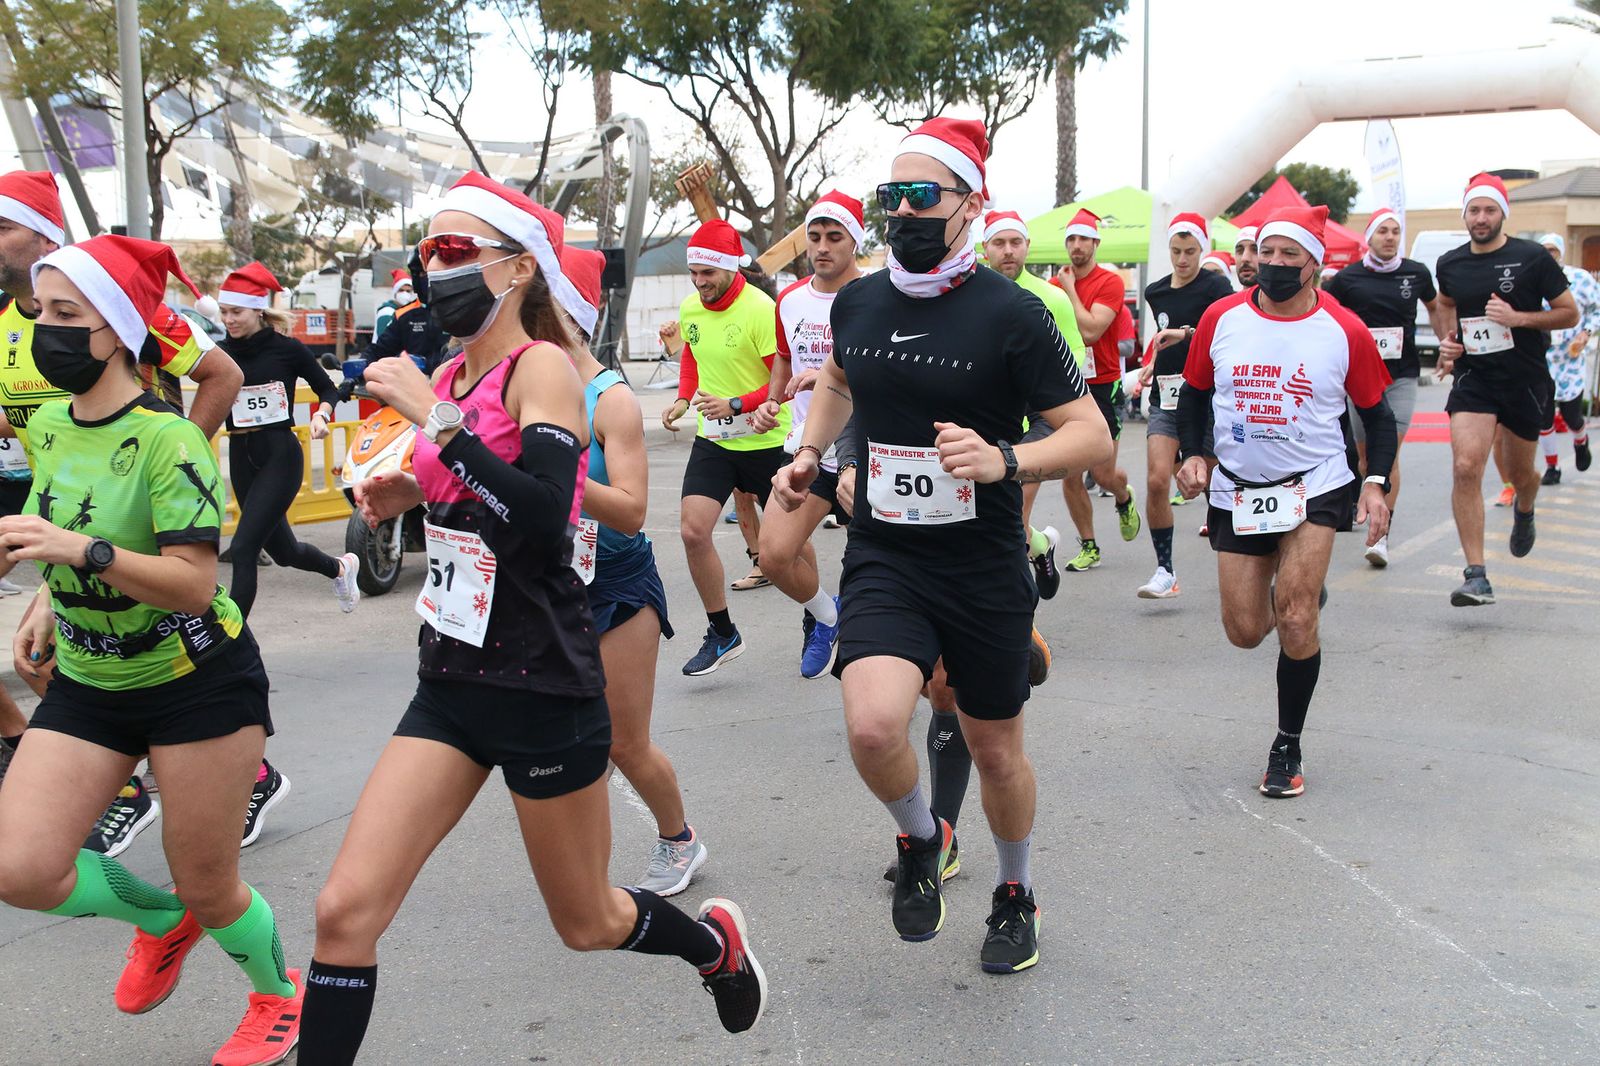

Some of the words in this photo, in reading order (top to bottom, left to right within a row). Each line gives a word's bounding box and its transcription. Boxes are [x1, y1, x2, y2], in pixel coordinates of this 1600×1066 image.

[680, 163, 712, 194] INRI
[695, 250, 723, 263] Navidad
[823, 323, 833, 340] Co
[1473, 329, 1490, 340] 41
[1232, 365, 1249, 376] XII
[1252, 364, 1282, 378] SAN
[12, 380, 34, 392] AGRO
[1233, 379, 1277, 389] SILVESTRE
[1234, 390, 1271, 401] COMARCA
[1272, 393, 1284, 402] DE
[247, 396, 268, 411] 55
[877, 447, 889, 456] SAN
[890, 449, 926, 459] SILVESTRE
[894, 473, 934, 498] 50
[464, 474, 510, 523] LURBEL
[1252, 496, 1279, 514] 20
[448, 533, 474, 544] COMARCA
[429, 557, 456, 592] 51
[309, 970, 369, 988] LURBEL
